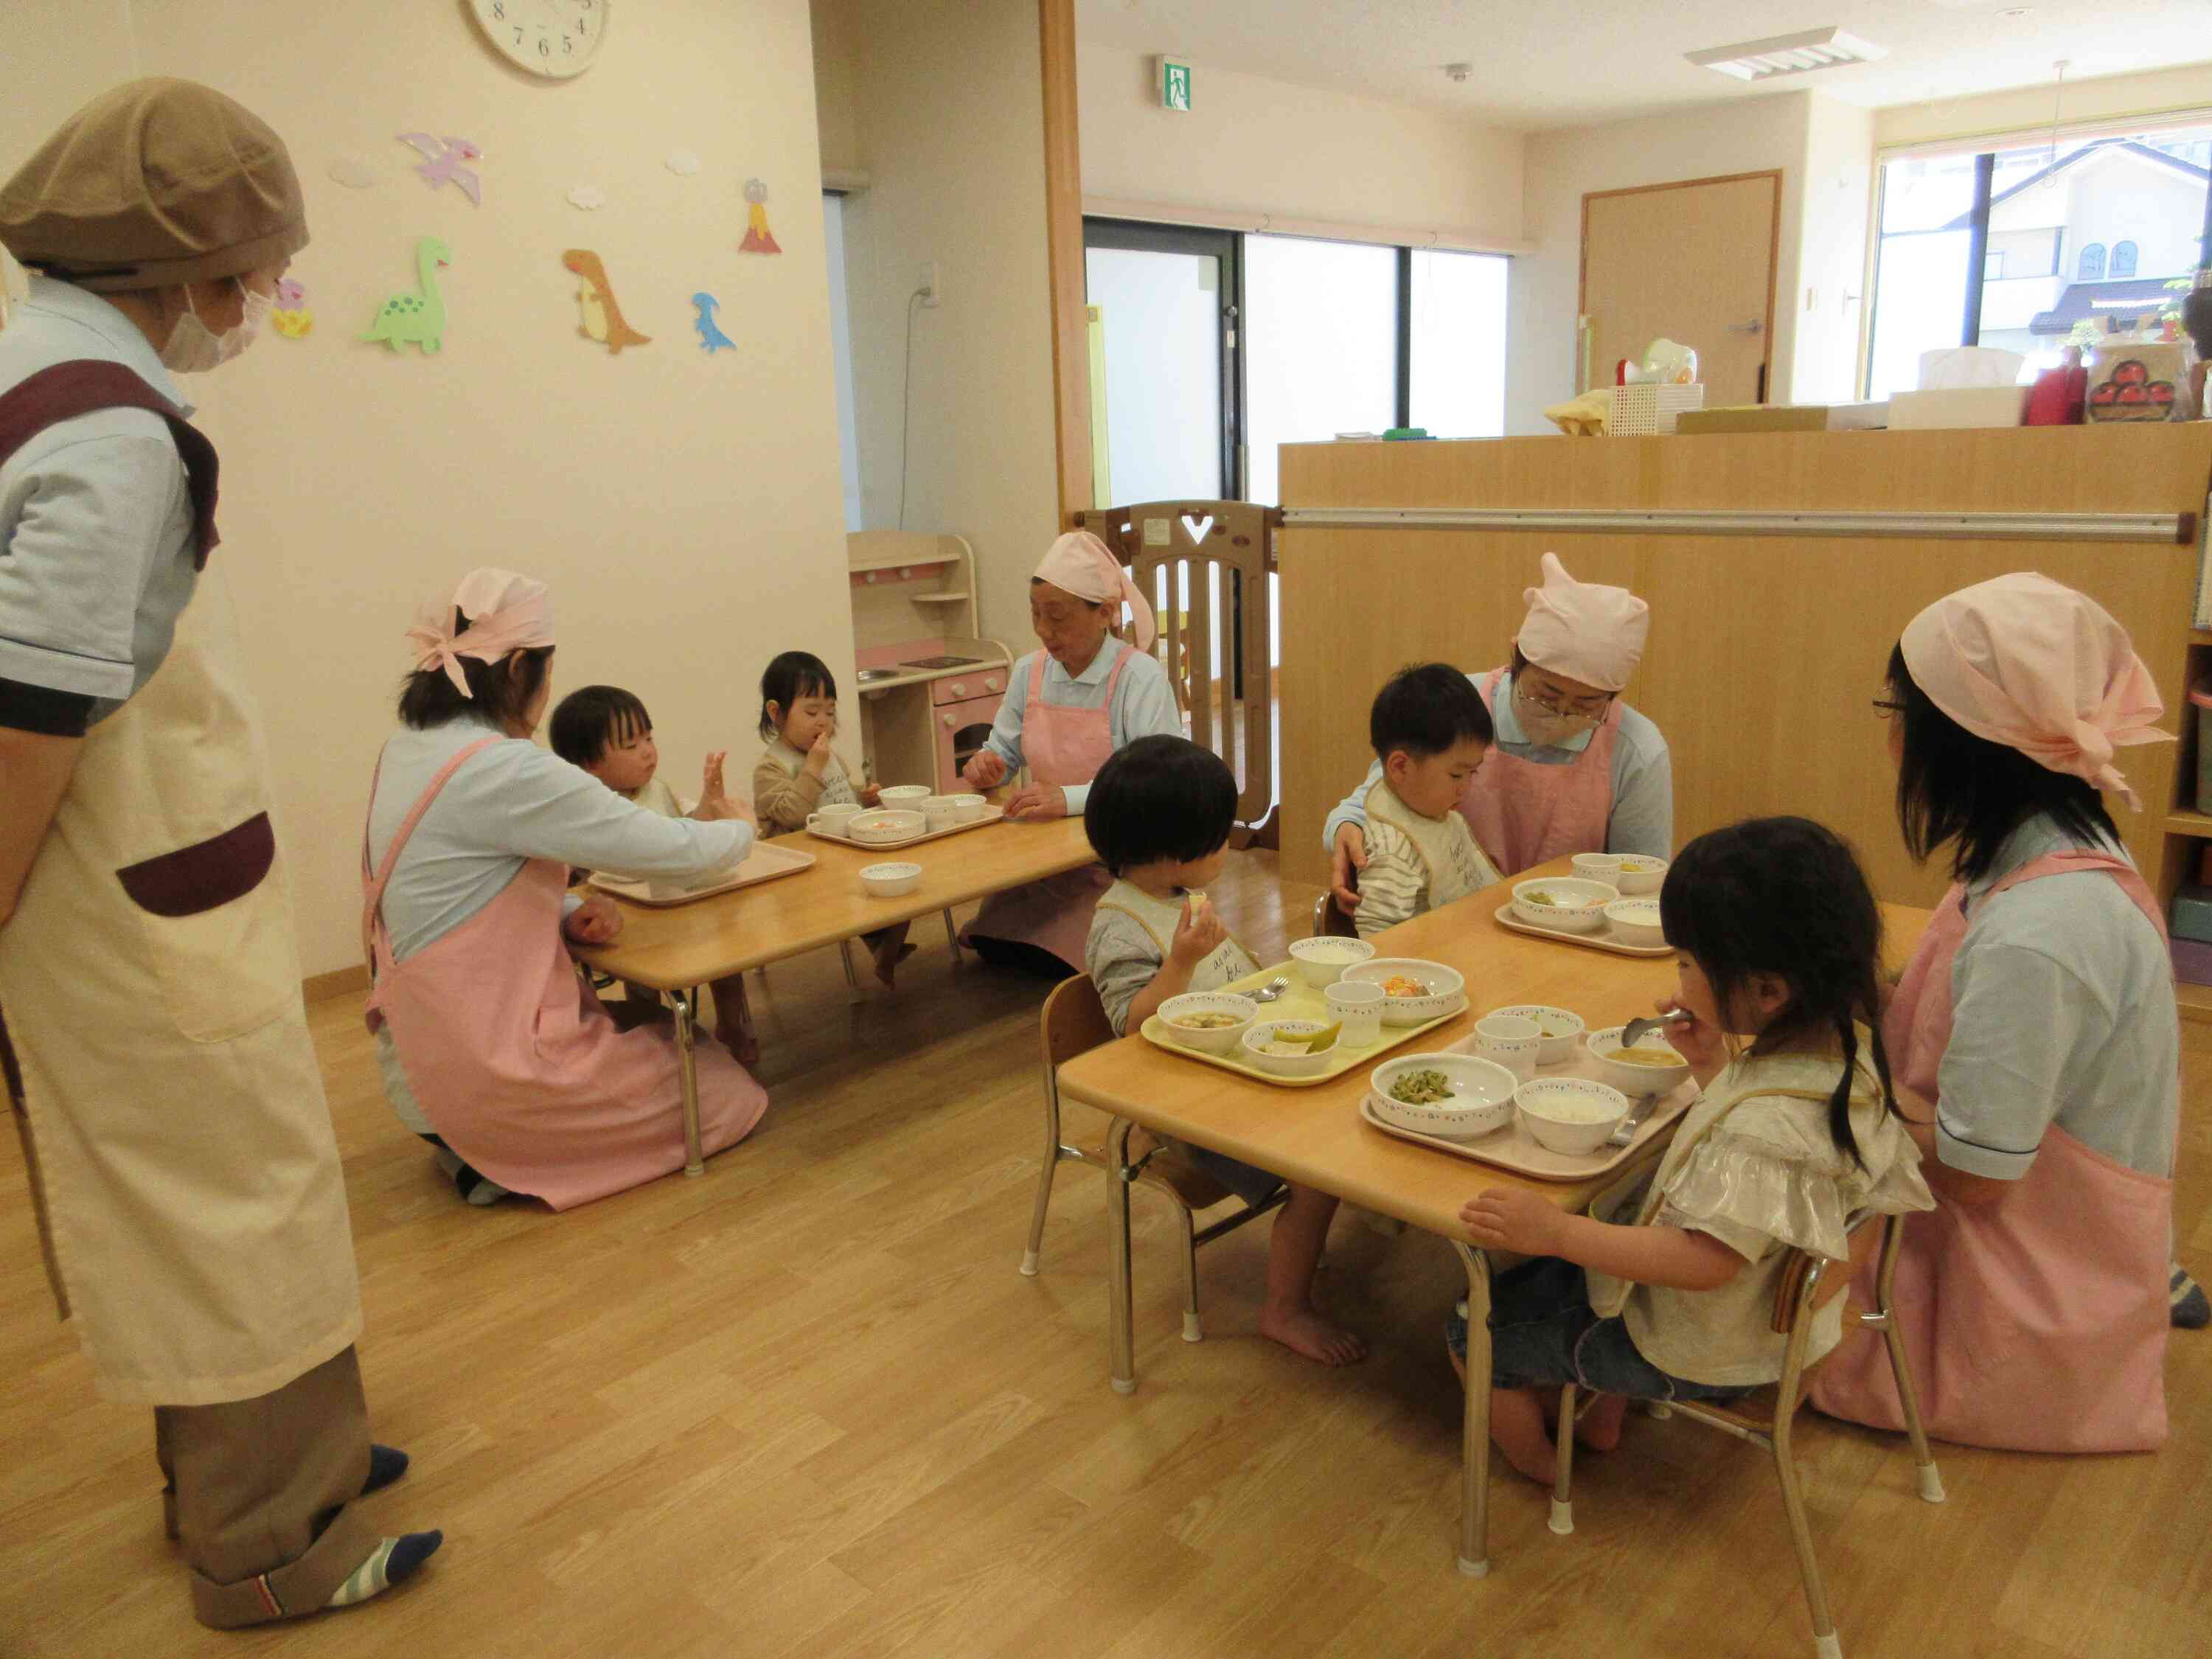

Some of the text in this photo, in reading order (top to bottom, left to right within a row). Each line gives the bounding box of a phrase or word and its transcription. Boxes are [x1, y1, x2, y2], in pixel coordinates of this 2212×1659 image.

[493, 1, 505, 20] 8
[513, 27, 524, 45] 7
[562, 35, 572, 54] 5
[538, 38, 549, 57] 6
